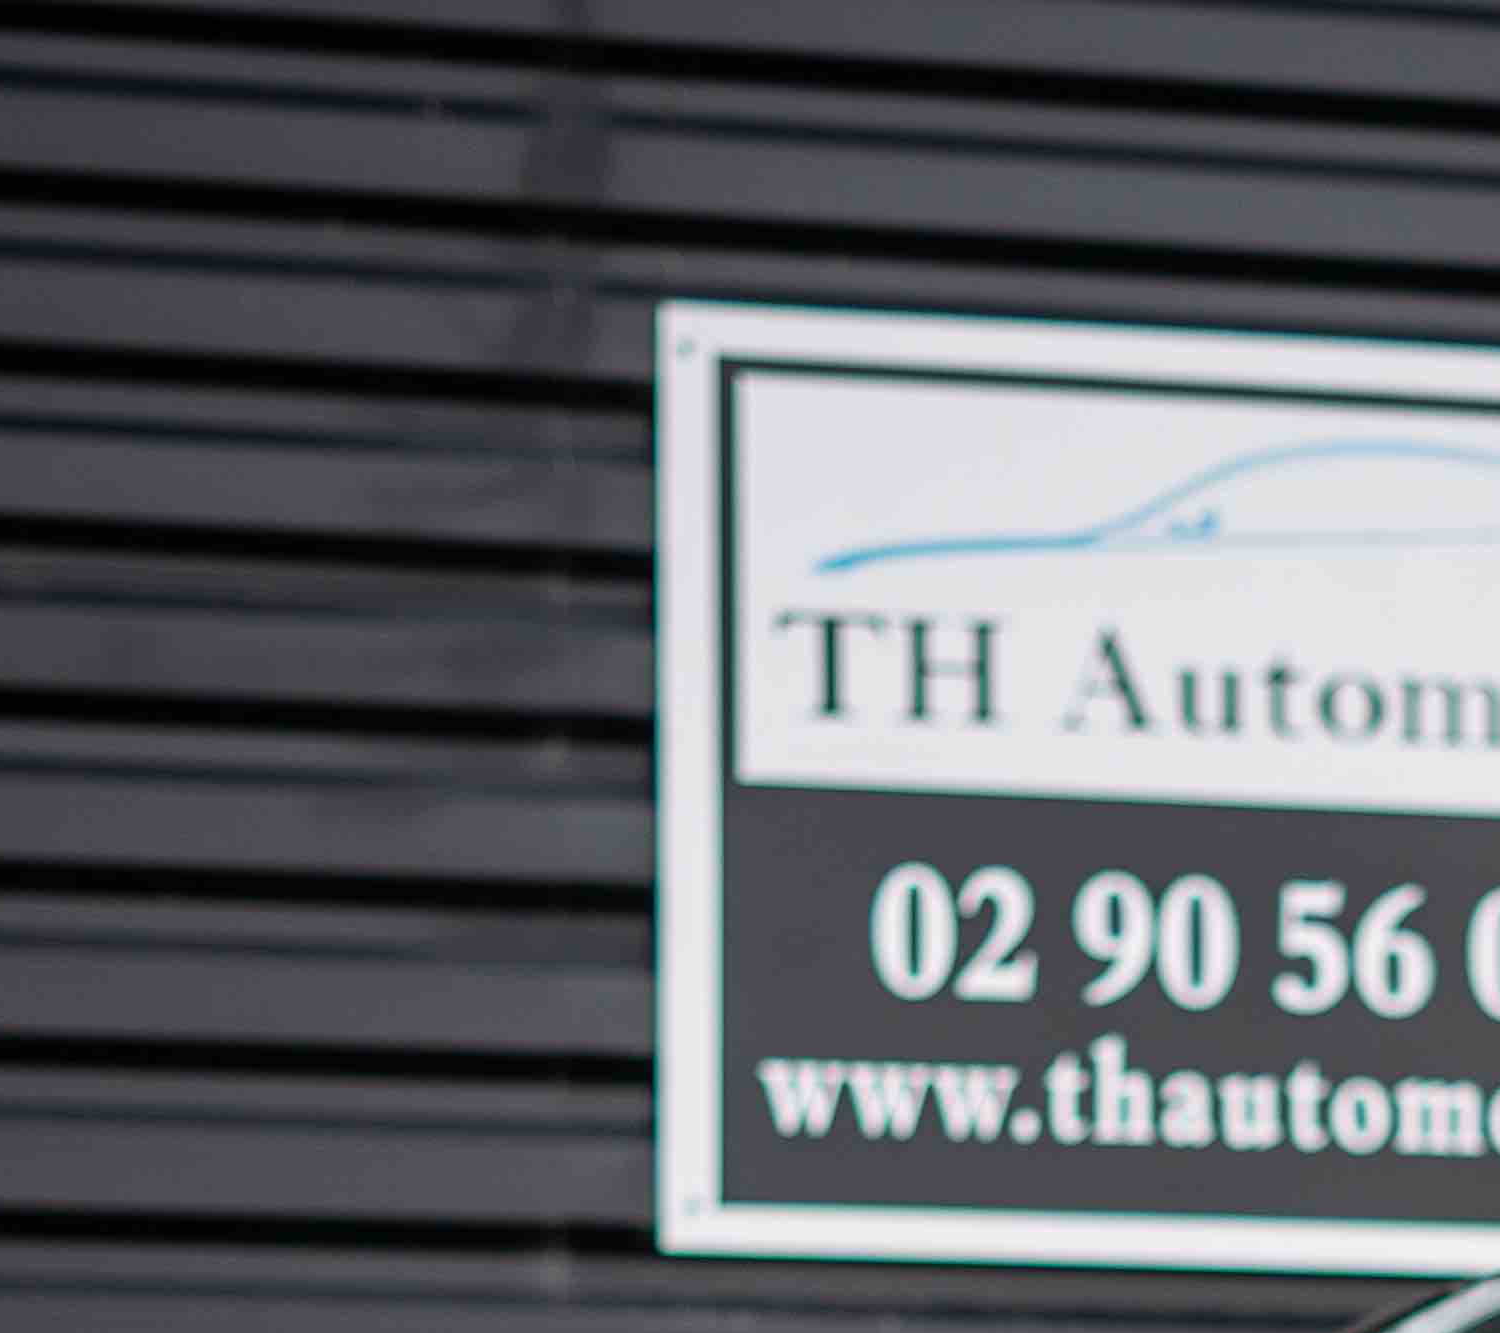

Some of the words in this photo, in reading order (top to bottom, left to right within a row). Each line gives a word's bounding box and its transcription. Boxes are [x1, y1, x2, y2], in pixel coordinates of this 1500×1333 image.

[772, 608, 1004, 724] TH
[870, 862, 1038, 1001] 02
[1073, 870, 1240, 1011] 90
[1272, 881, 1435, 1019] 56
